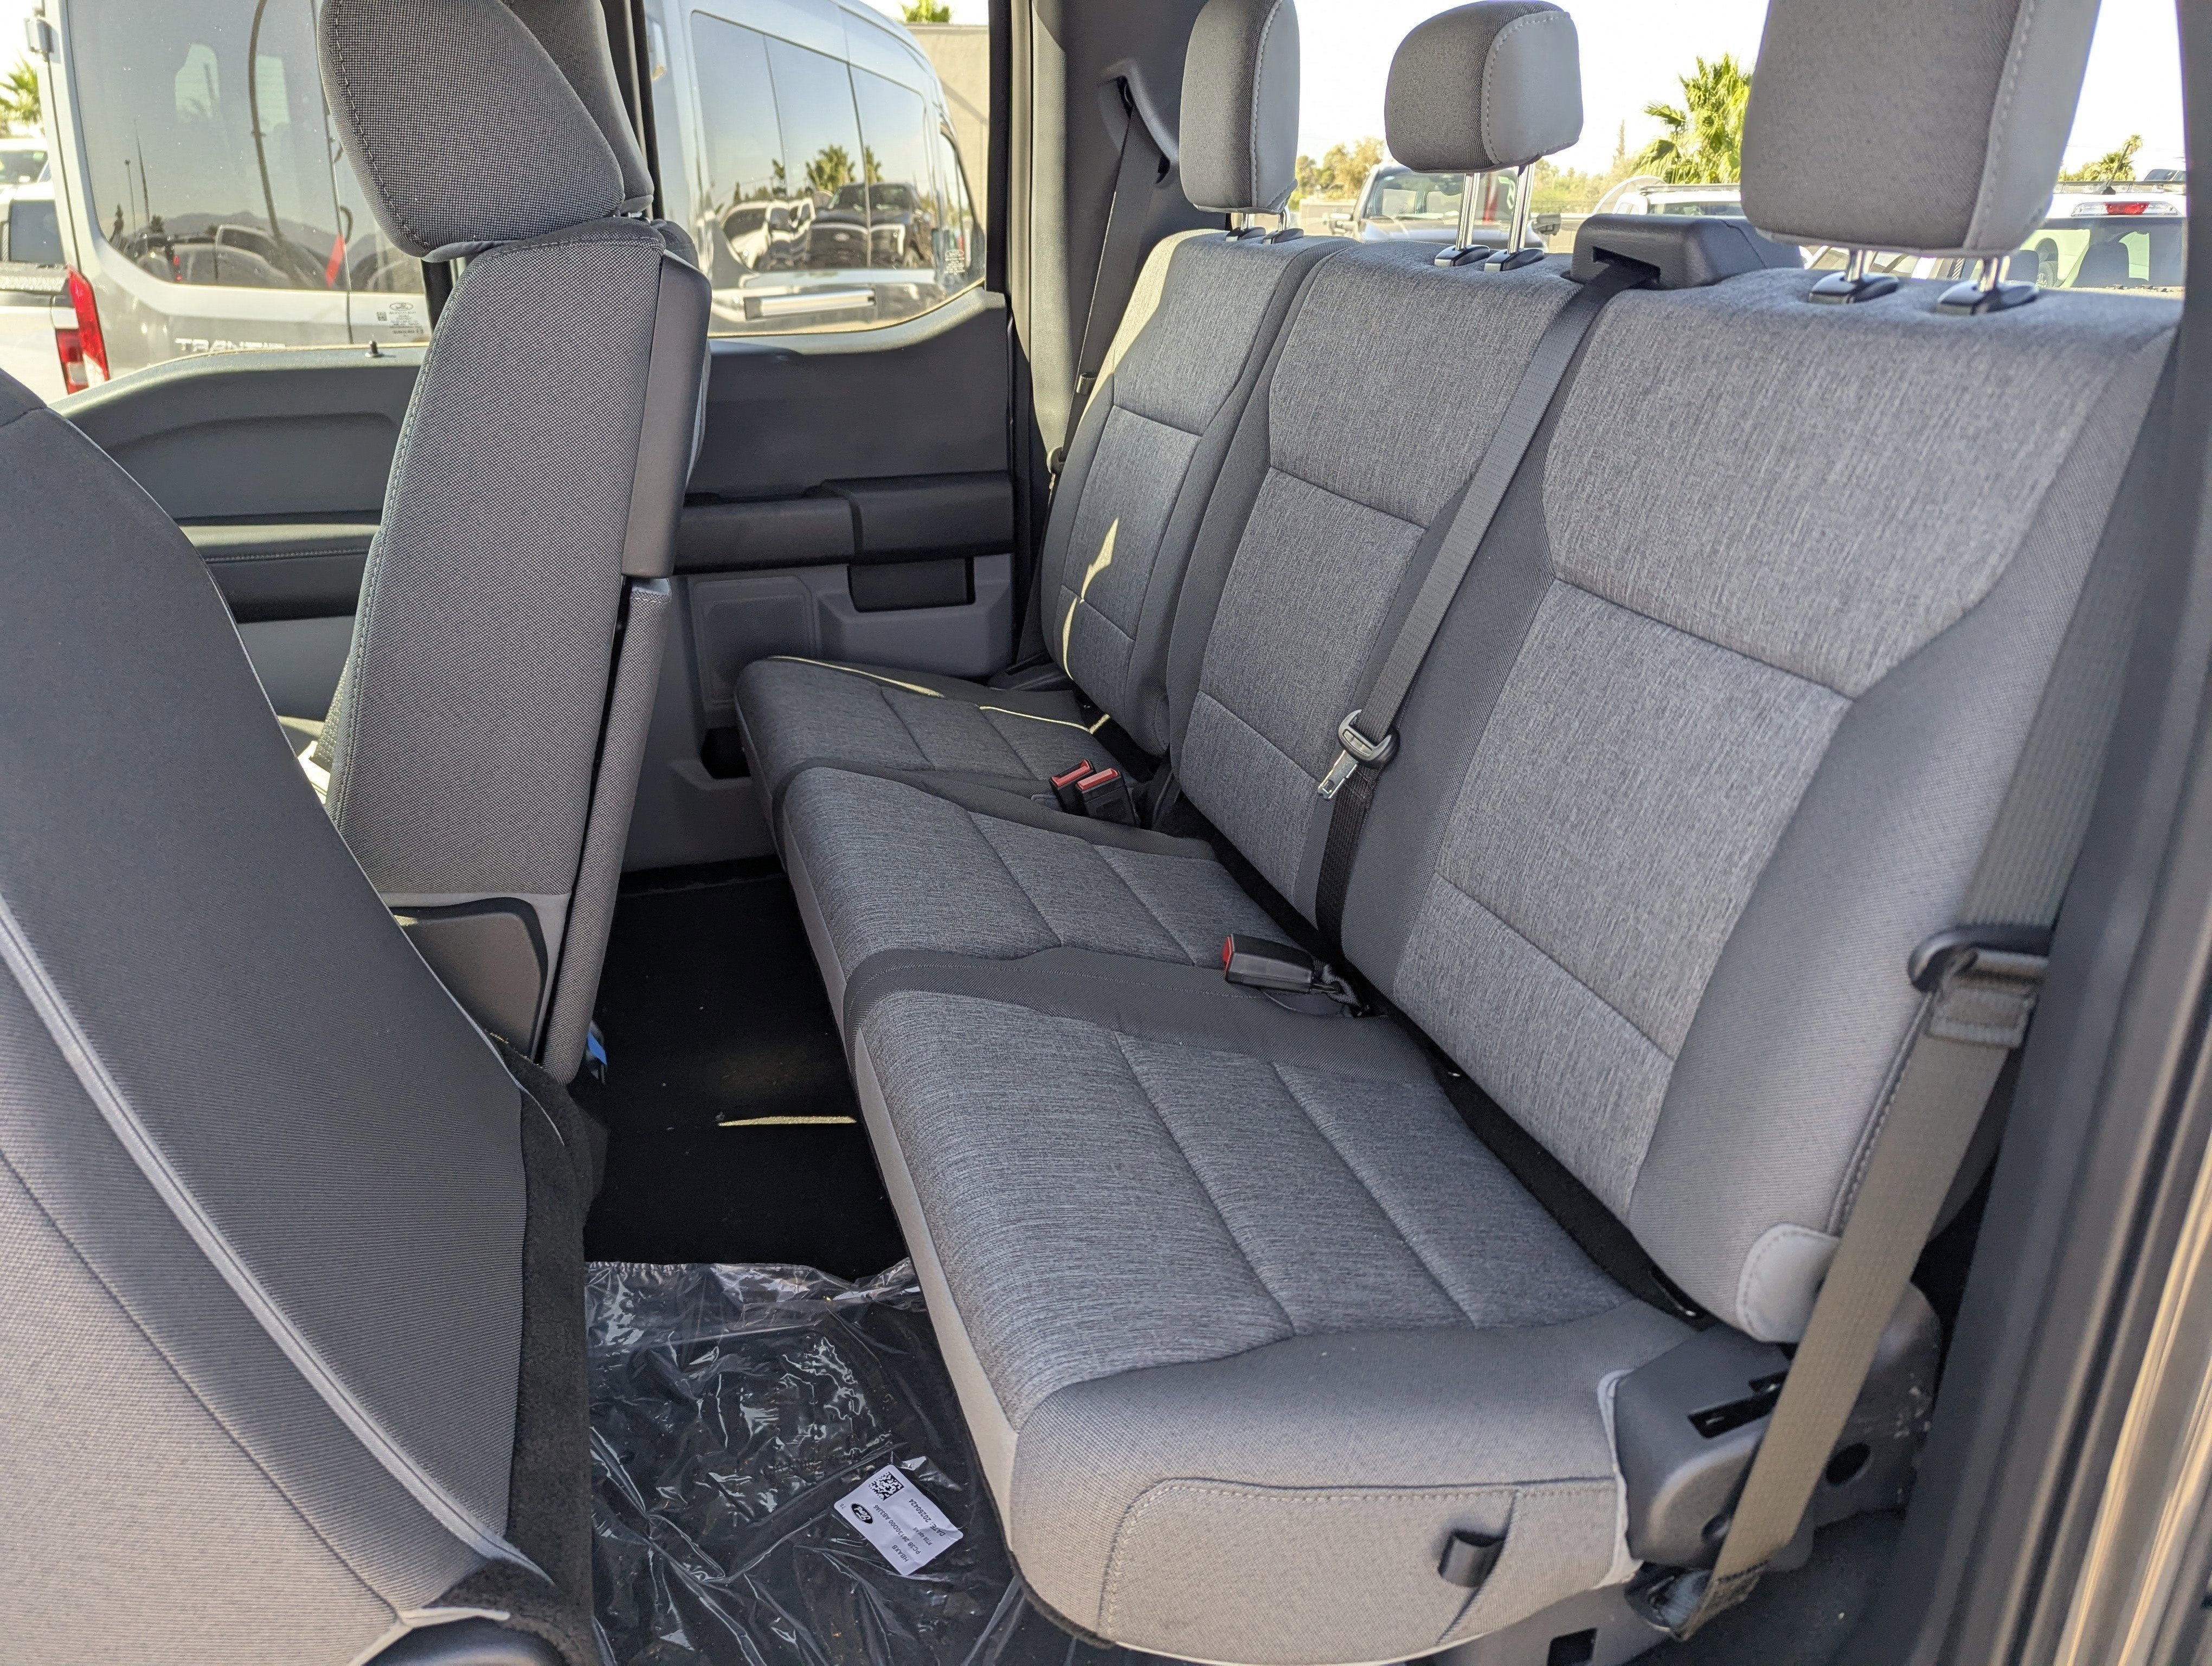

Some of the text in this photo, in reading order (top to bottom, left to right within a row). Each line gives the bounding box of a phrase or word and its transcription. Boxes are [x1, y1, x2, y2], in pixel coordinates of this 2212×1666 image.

[853, 1504, 872, 1522] Ford
[908, 1498, 946, 1537] DATE: 20250424
